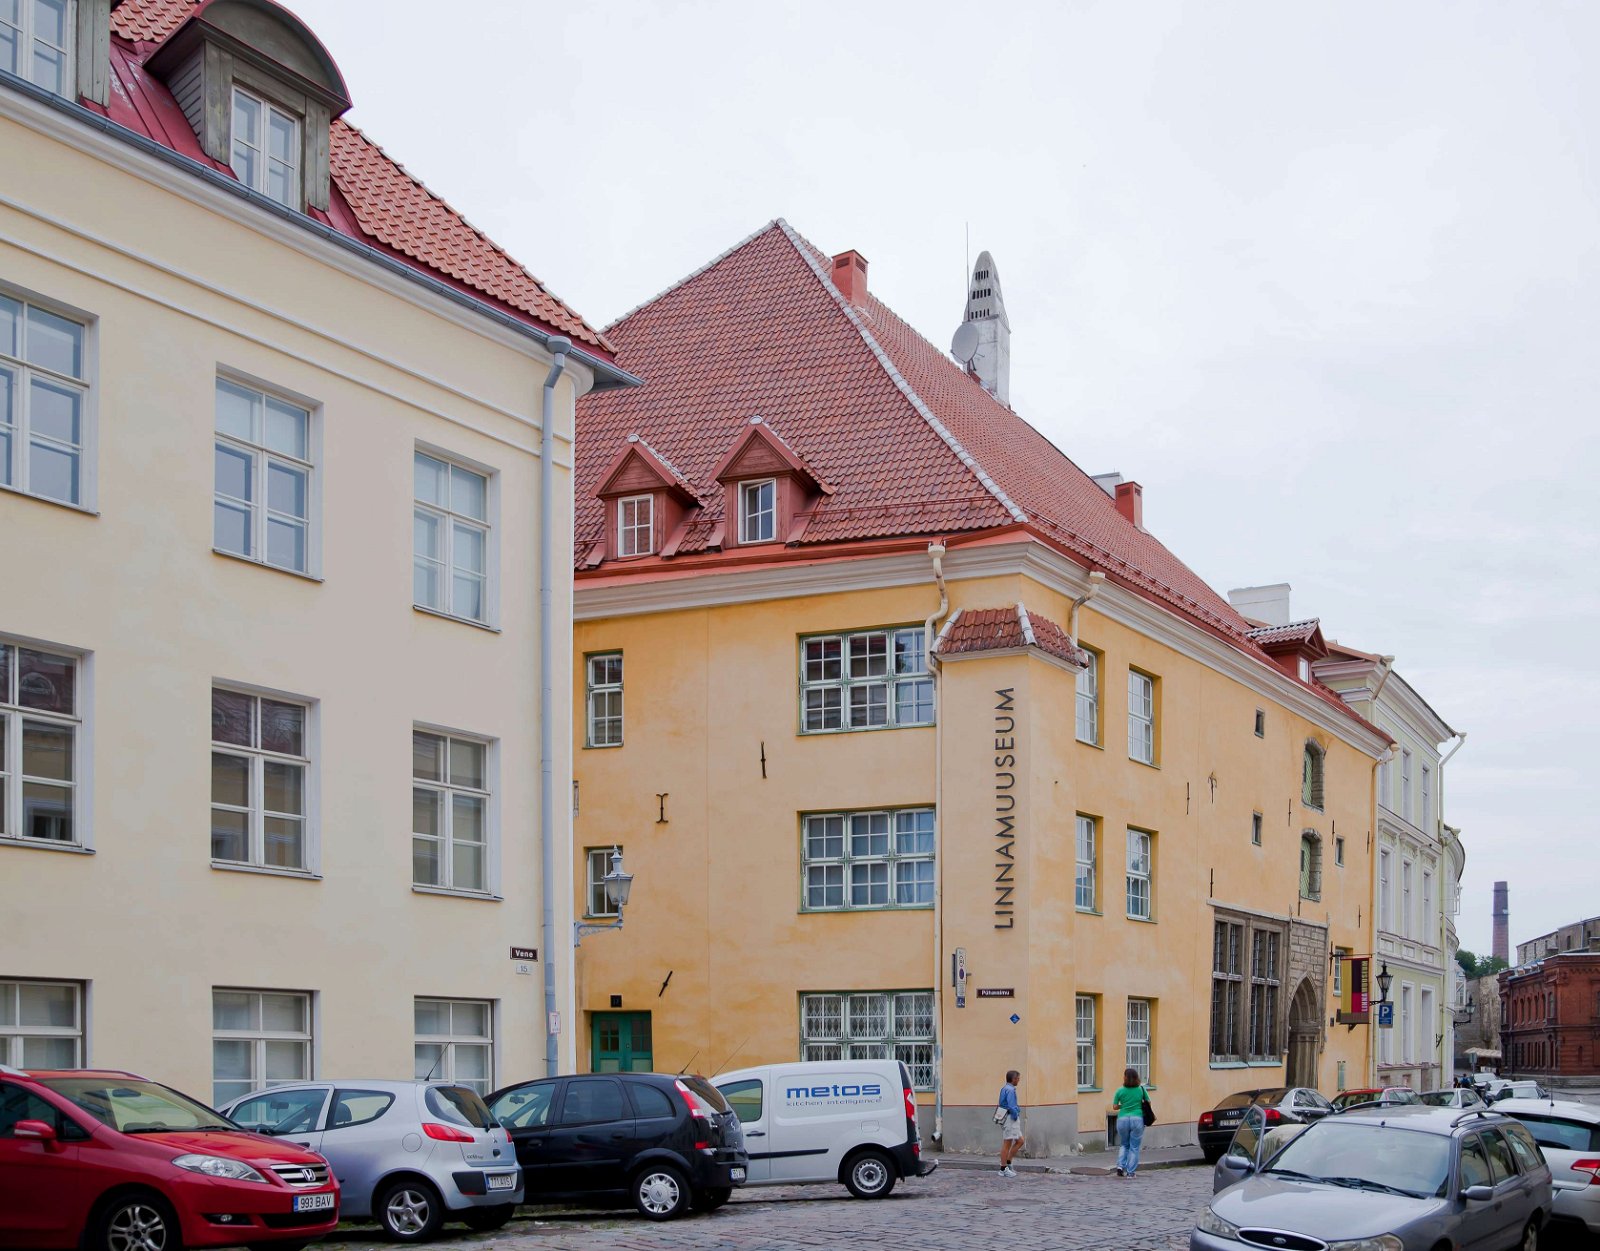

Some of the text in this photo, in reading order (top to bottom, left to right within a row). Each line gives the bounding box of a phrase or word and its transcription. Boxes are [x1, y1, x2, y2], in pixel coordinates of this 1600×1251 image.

[994, 687, 1015, 929] LINNAMUUSEUM
[515, 949, 534, 958] Vene
[1381, 1006, 1390, 1018] P
[786, 1084, 881, 1099] metos
[826, 1098, 882, 1106] intelligence
[300, 1195, 332, 1209] 993 BAV
